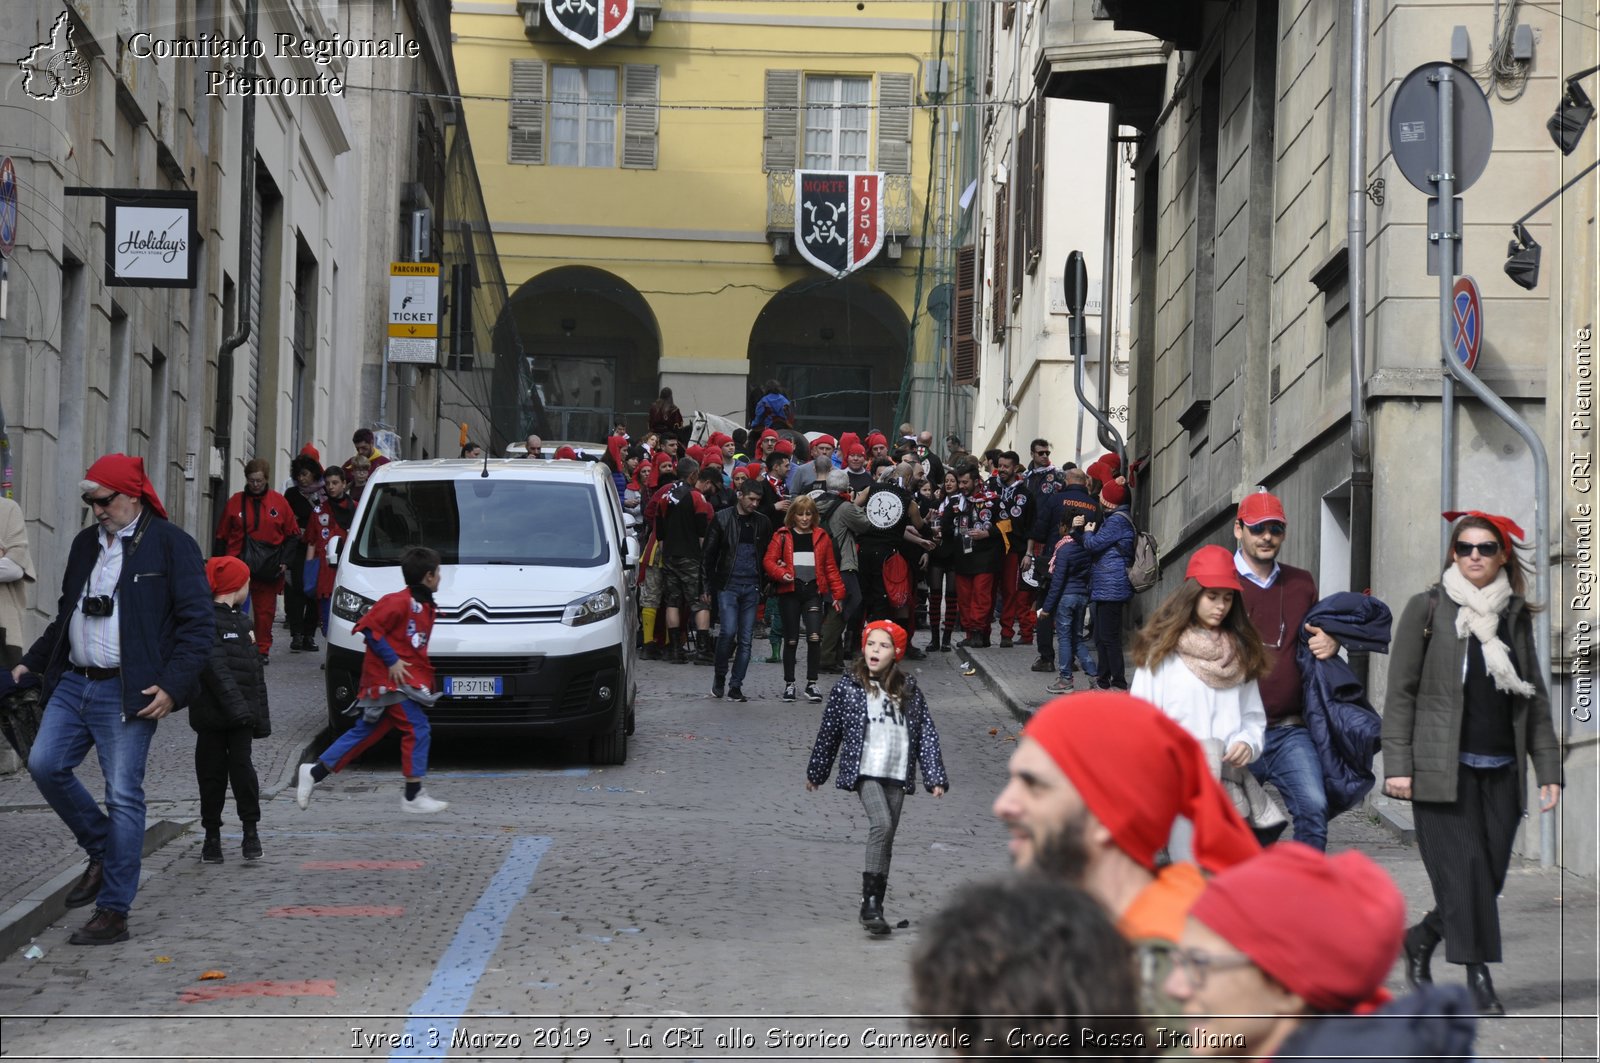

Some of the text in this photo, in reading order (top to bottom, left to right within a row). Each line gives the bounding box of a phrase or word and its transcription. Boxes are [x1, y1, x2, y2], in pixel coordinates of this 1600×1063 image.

[803, 180, 846, 193] MORTE
[117, 229, 187, 263] Holiday's
[393, 265, 436, 273] PARCOMETRO
[393, 312, 433, 321] TICKET
